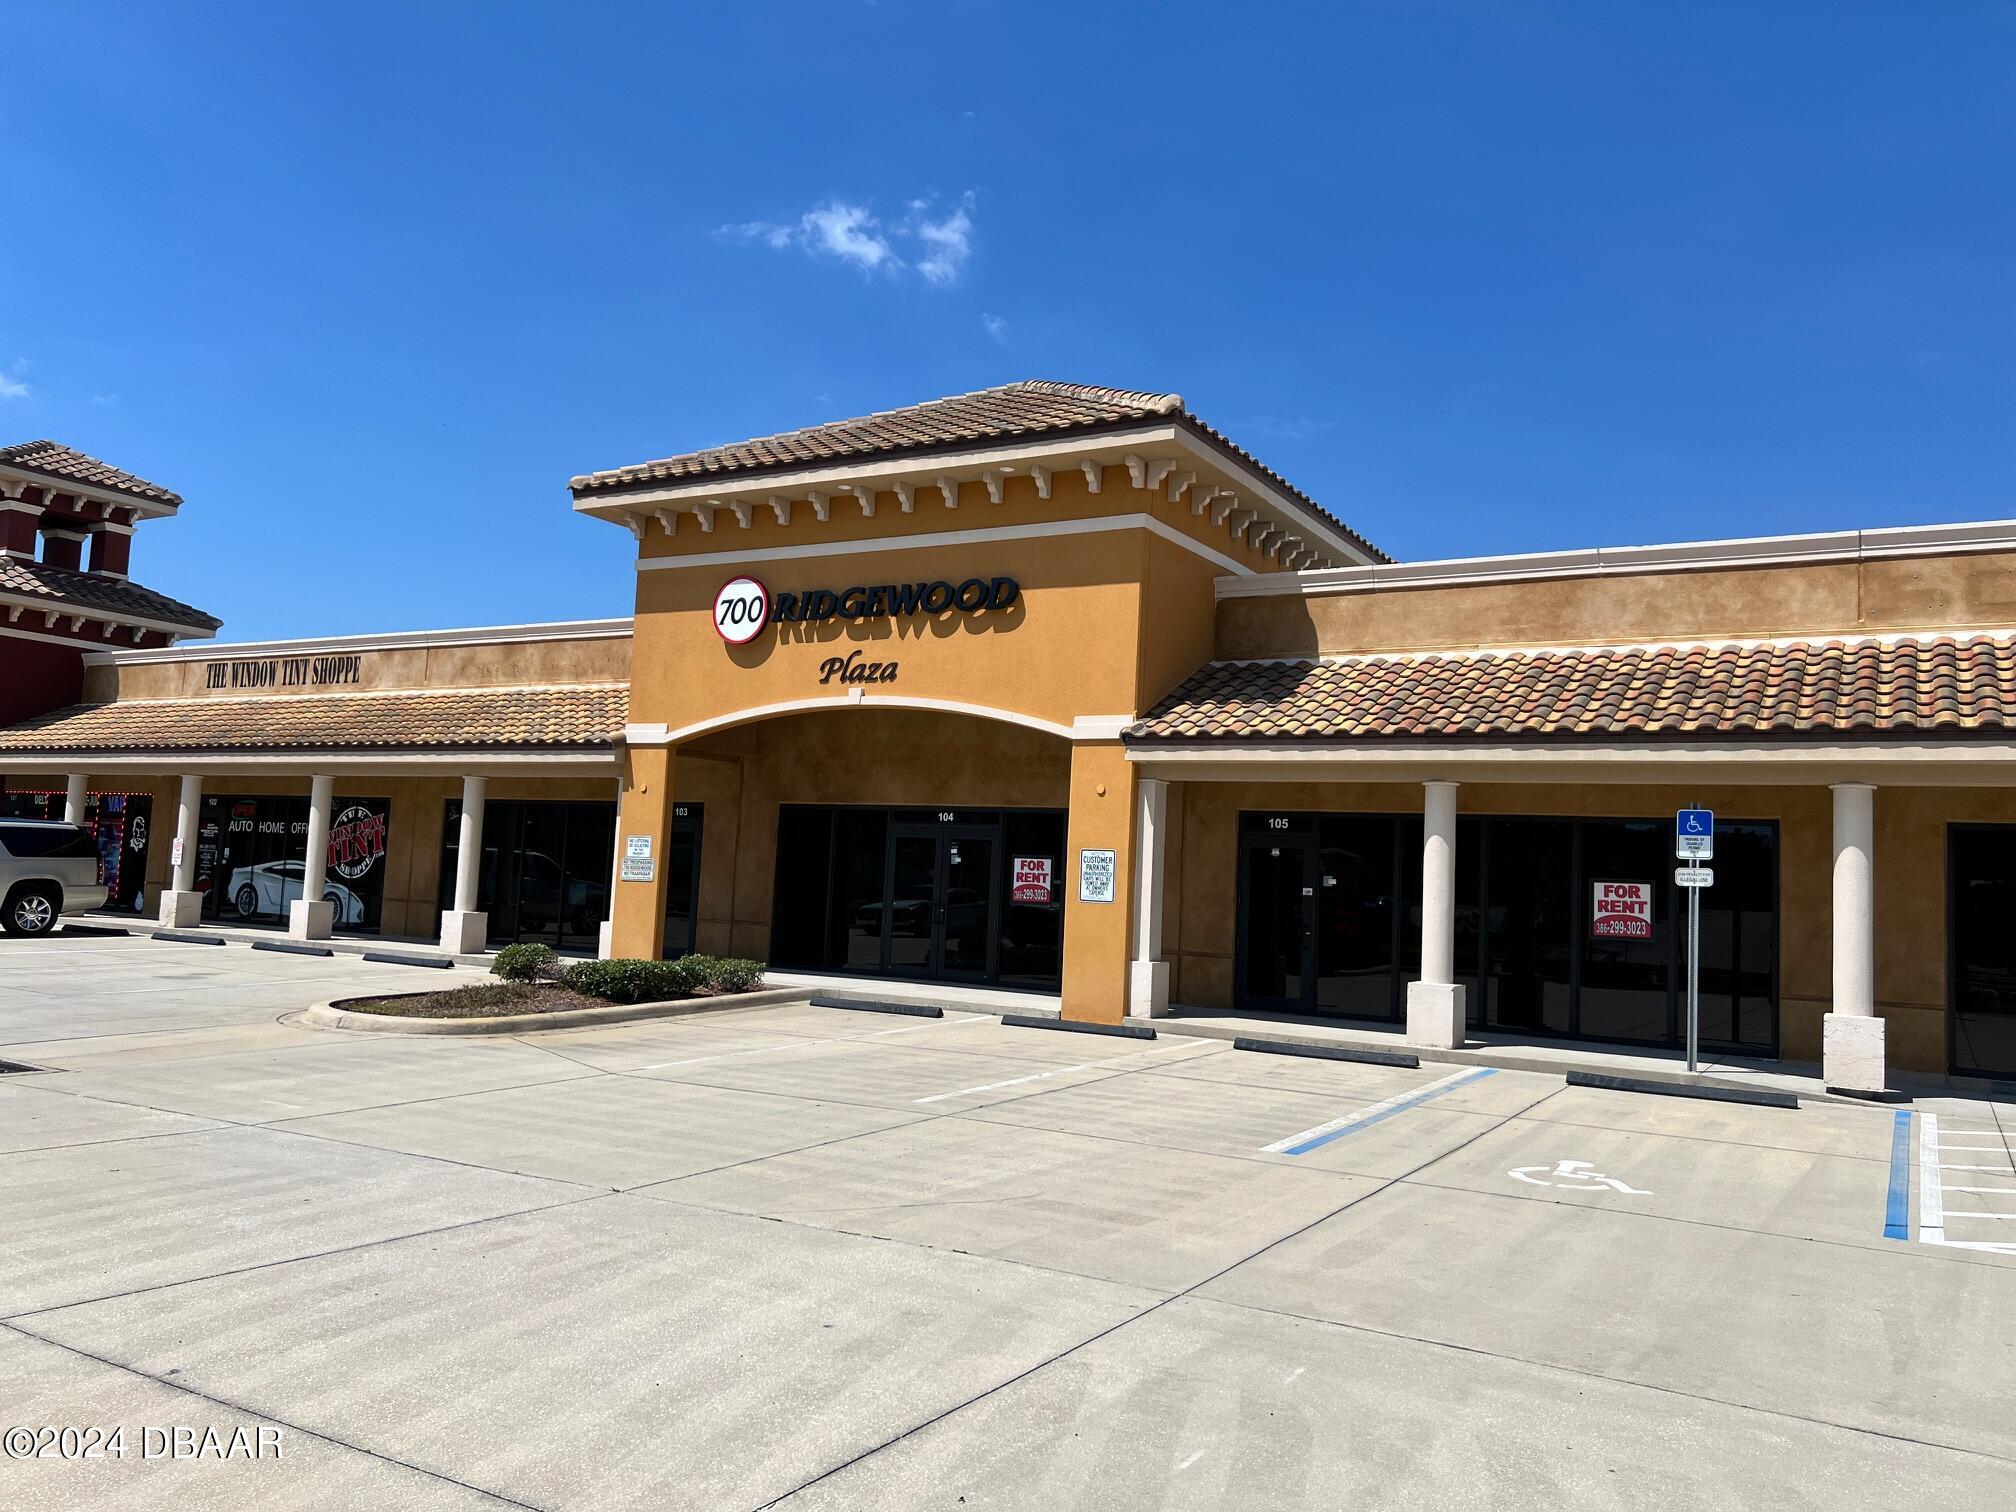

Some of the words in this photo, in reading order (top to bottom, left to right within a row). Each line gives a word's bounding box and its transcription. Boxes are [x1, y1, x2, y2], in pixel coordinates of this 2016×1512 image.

[718, 595, 764, 625] 700
[771, 577, 1019, 623] RIDGEWOOD
[206, 662, 228, 688] THE
[231, 660, 279, 688] WINDOW
[282, 658, 310, 686] TINT
[312, 656, 362, 685] SHOPPE
[819, 650, 898, 684] Plaza
[675, 807, 688, 816] 103
[938, 812, 954, 822] 104
[228, 820, 254, 832] AUTO
[258, 821, 285, 834] HOME
[1268, 818, 1289, 829] 105
[328, 825, 386, 867] TINT
[340, 855, 373, 875] SHOPPE
[1020, 860, 1045, 871] FOR
[1083, 855, 1112, 864] CUSTOMER
[1085, 863, 1109, 872] PARKING
[1016, 872, 1049, 883] RENT
[1603, 884, 1641, 899] FOR
[1597, 899, 1648, 914] RENT
[1596, 920, 1646, 935] 386-299-3023
